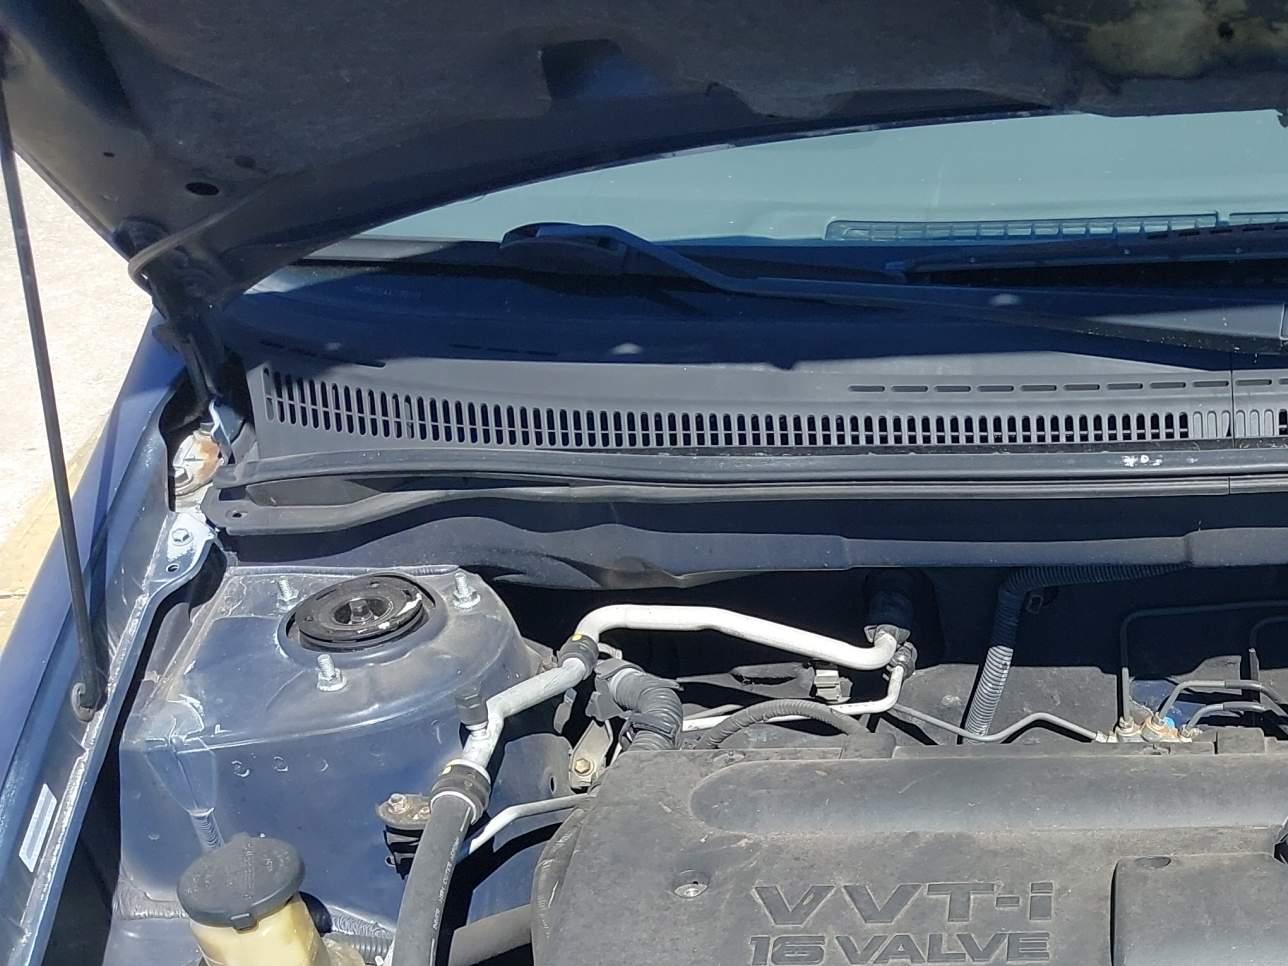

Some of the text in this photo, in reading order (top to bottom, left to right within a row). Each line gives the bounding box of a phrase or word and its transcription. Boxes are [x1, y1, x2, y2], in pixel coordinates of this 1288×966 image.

[752, 882, 1054, 925] VVT-i
[750, 931, 1051, 966] 16 VALVE
